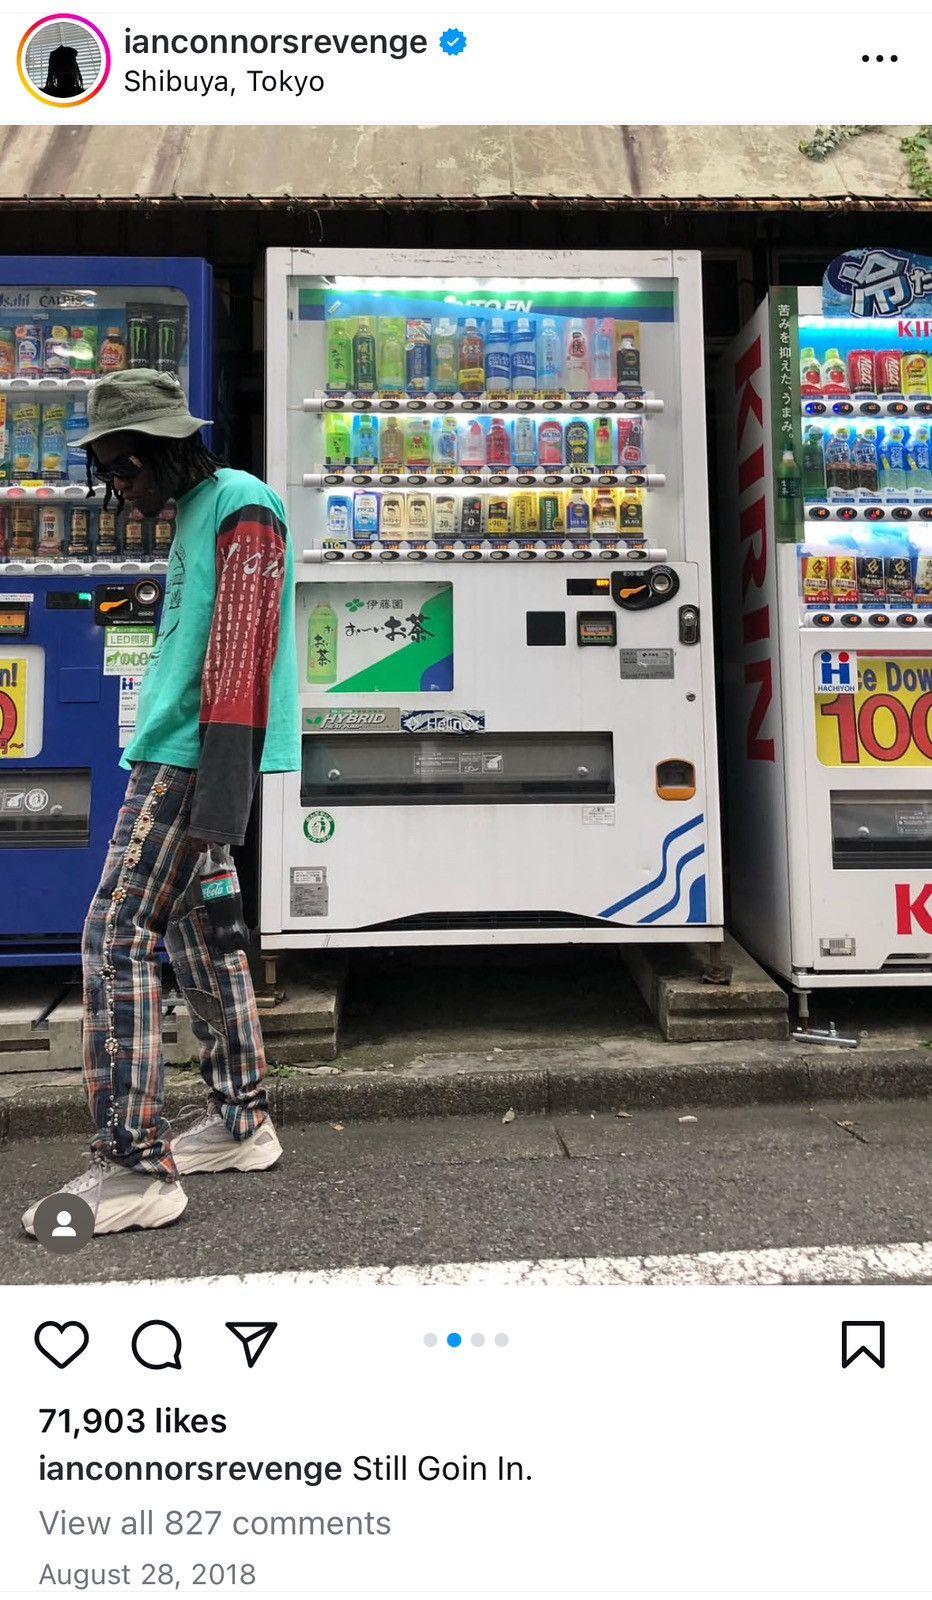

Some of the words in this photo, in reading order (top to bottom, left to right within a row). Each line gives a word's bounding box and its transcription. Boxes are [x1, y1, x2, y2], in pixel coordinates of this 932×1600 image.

[734, 334, 776, 763] KIRIN
[365, 599, 404, 610] 伊藤園
[110, 634, 150, 645] LED照明
[322, 713, 386, 725] HYBRID
